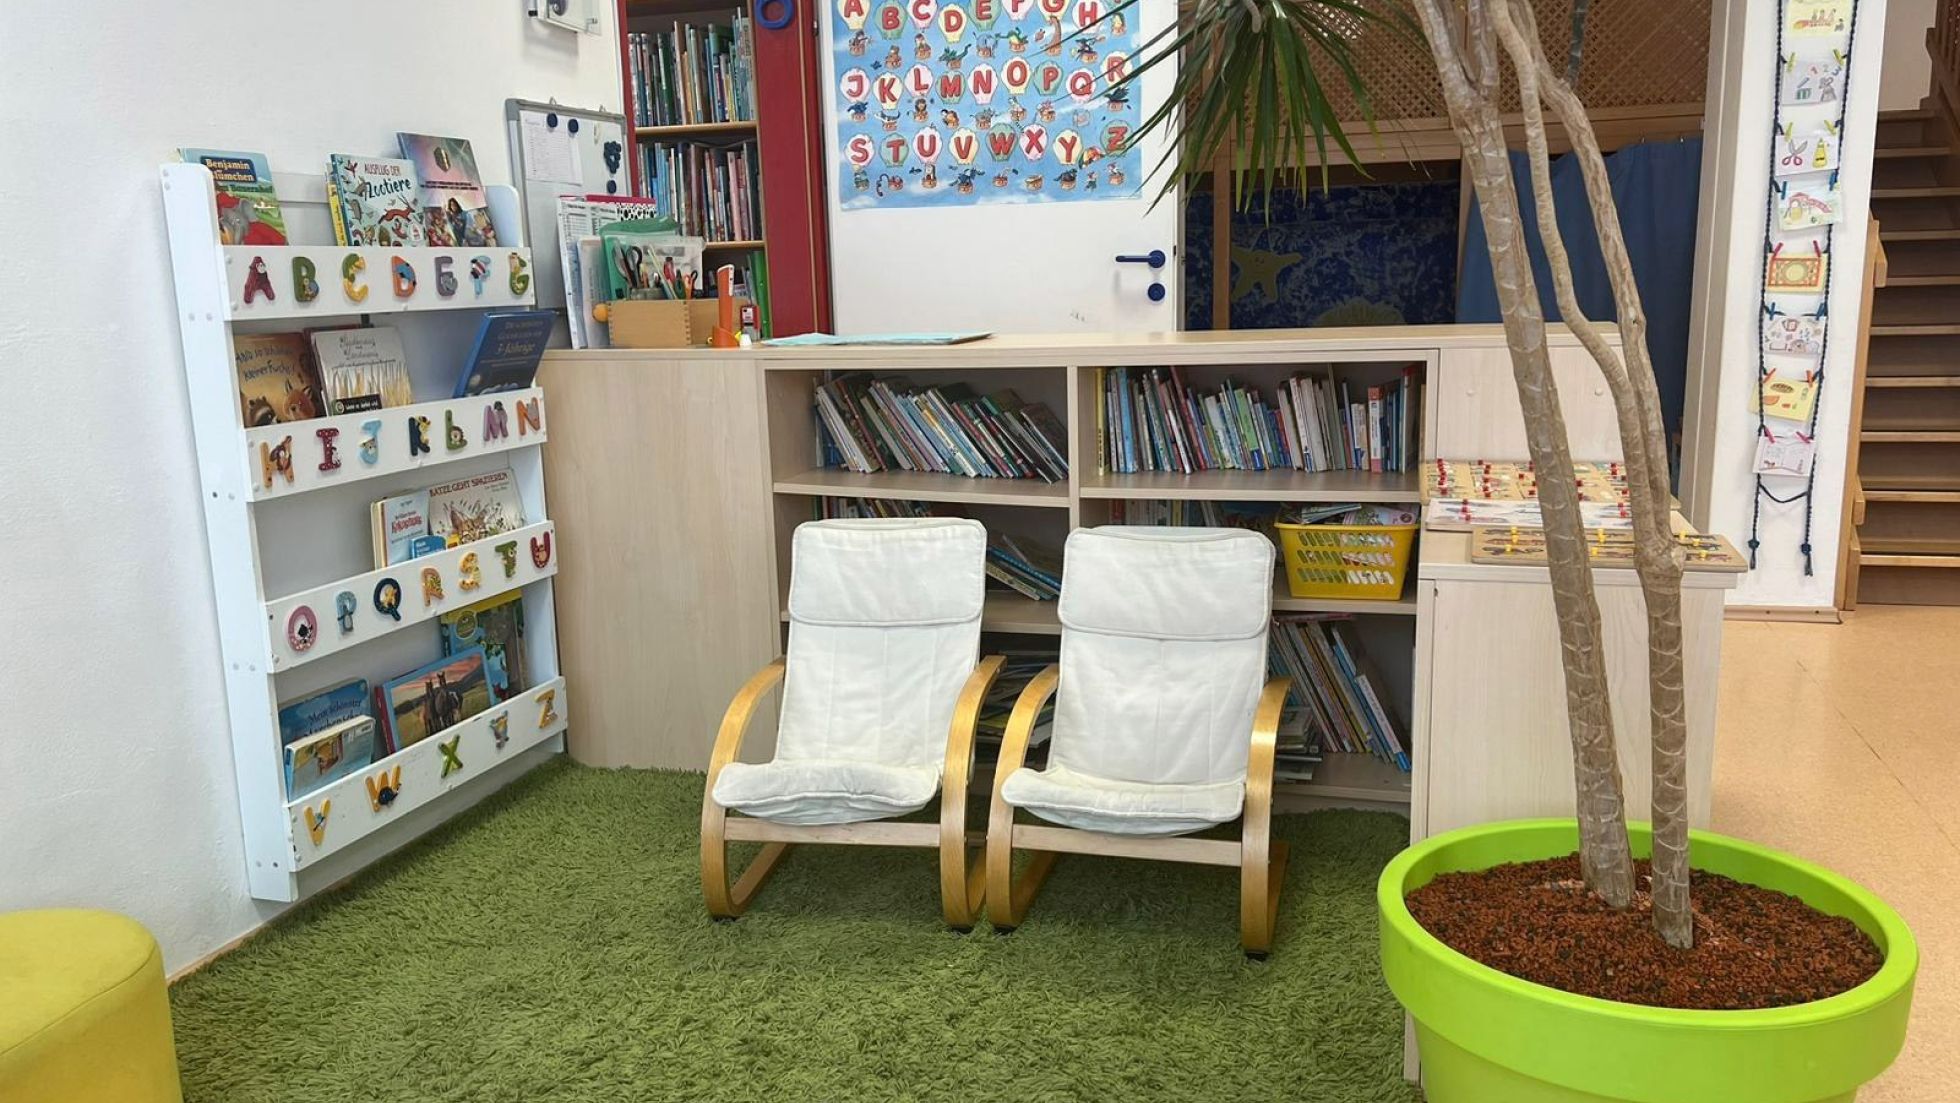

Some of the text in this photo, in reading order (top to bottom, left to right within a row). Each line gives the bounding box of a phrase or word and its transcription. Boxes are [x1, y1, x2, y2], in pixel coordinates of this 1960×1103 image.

[844, 0, 864, 18] A
[882, 6, 900, 30] B
[912, 0, 931, 20] C
[944, 9, 963, 33] D
[976, 0, 992, 20] E
[1079, 1, 1097, 27] H
[846, 56, 1126, 103] J K L M N O P Q R
[205, 158, 251, 170] Benjamin
[850, 126, 1128, 163] S T U V W X Y Z
[213, 170, 255, 182] lümchen
[365, 178, 411, 200] Zootiere
[243, 255, 275, 304] A
[291, 256, 320, 302] B
[342, 252, 369, 304] C
[391, 255, 417, 299] D
[434, 255, 458, 297] E
[470, 255, 491, 298] F
[316, 427, 342, 472] I
[359, 419, 383, 466] J
[408, 415, 431, 456] K
[444, 409, 468, 452] L
[483, 401, 509, 442] M
[516, 396, 541, 436] N
[287, 531, 551, 652] O P Q R S T U
[304, 688, 558, 846] V W X Y Z
